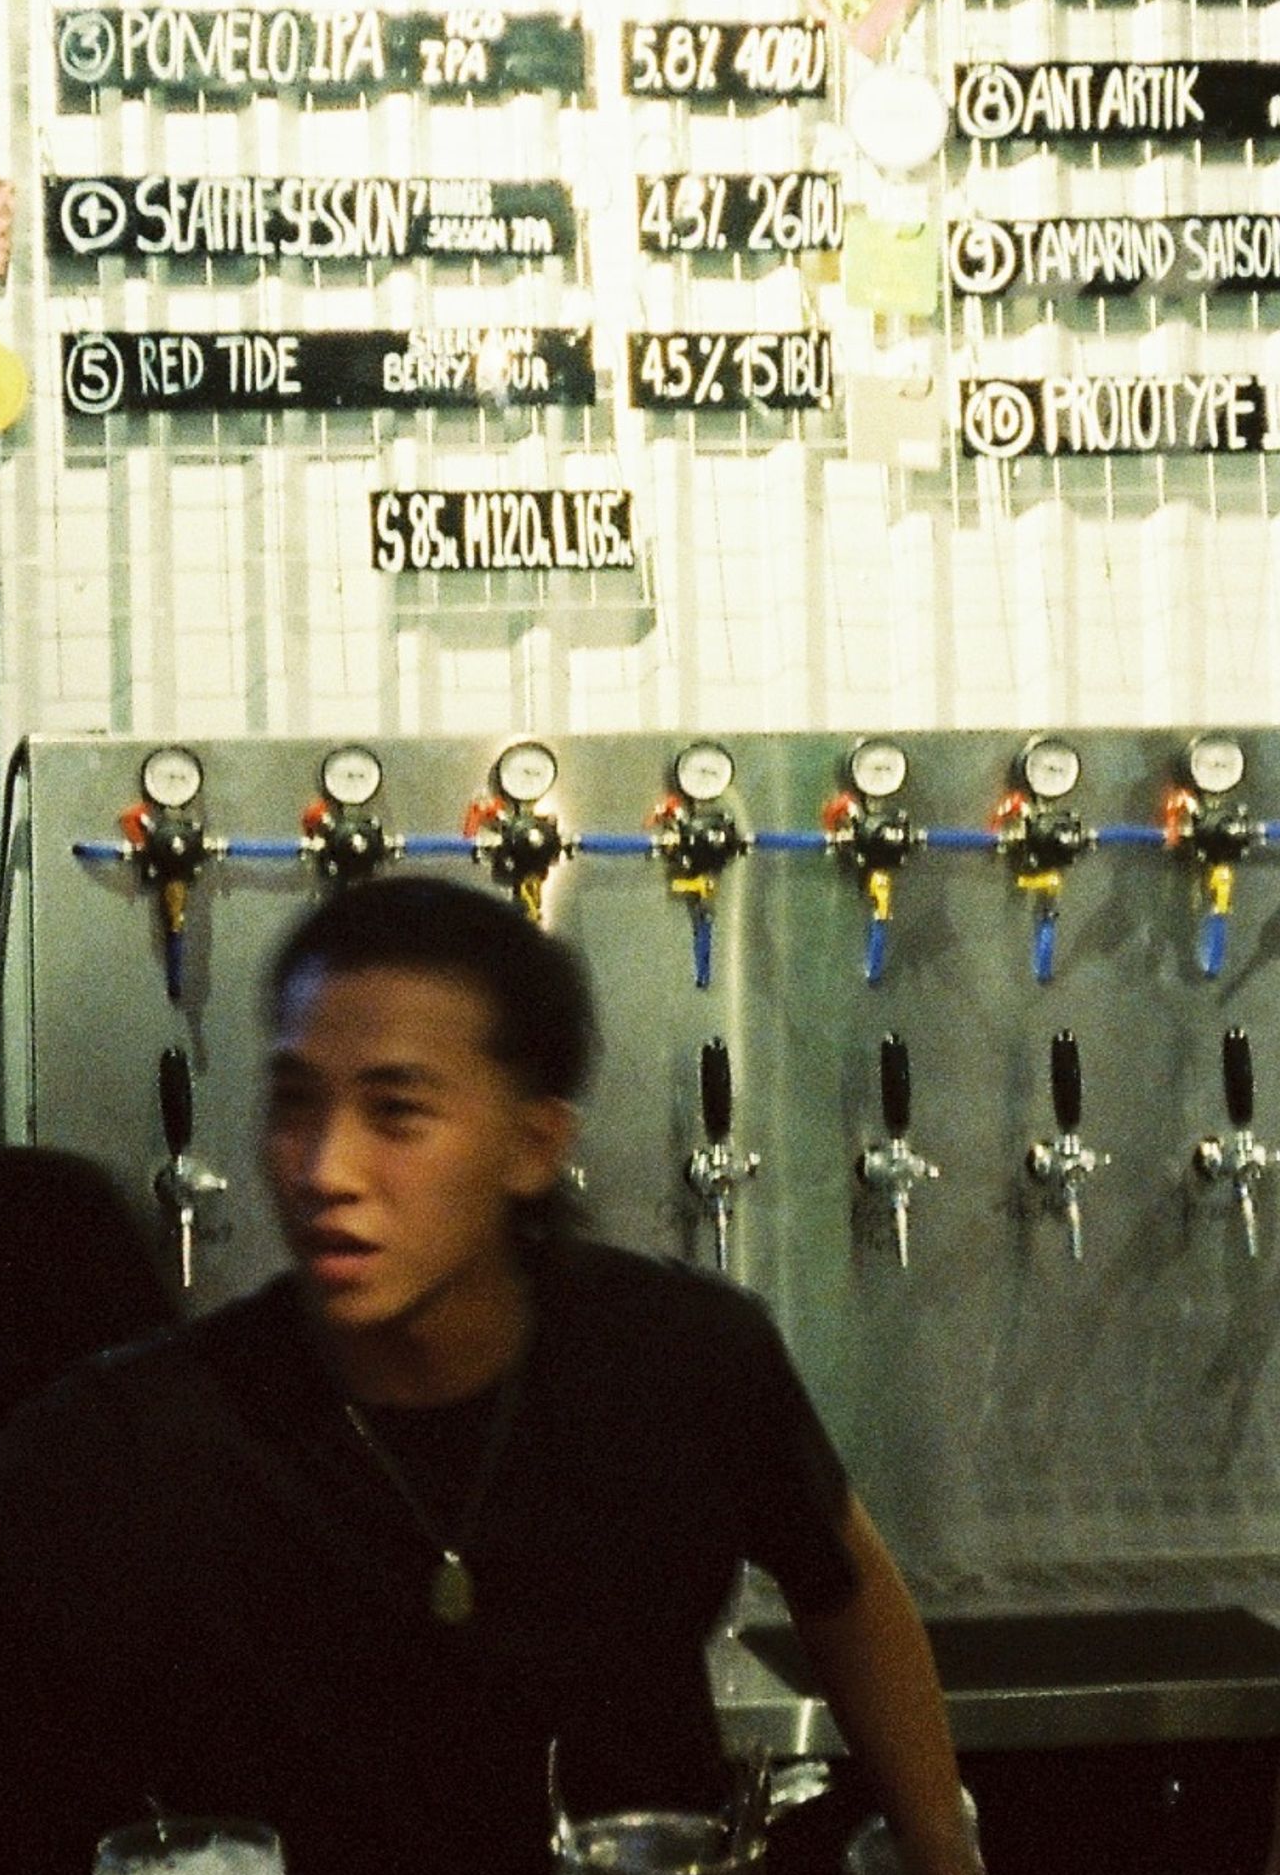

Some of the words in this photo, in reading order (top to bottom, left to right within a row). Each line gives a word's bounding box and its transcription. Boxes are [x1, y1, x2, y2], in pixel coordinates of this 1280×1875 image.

[121, 9, 300, 83] POMELO
[309, 9, 385, 83] IPA
[420, 38, 488, 84] IPA
[632, 26, 721, 90] 5.8%
[279, 177, 410, 258] SESSION
[1014, 217, 1176, 285] TAMARIND
[138, 336, 204, 395] RED
[215, 334, 302, 394] TIDE
[383, 352, 470, 393] BERRY
